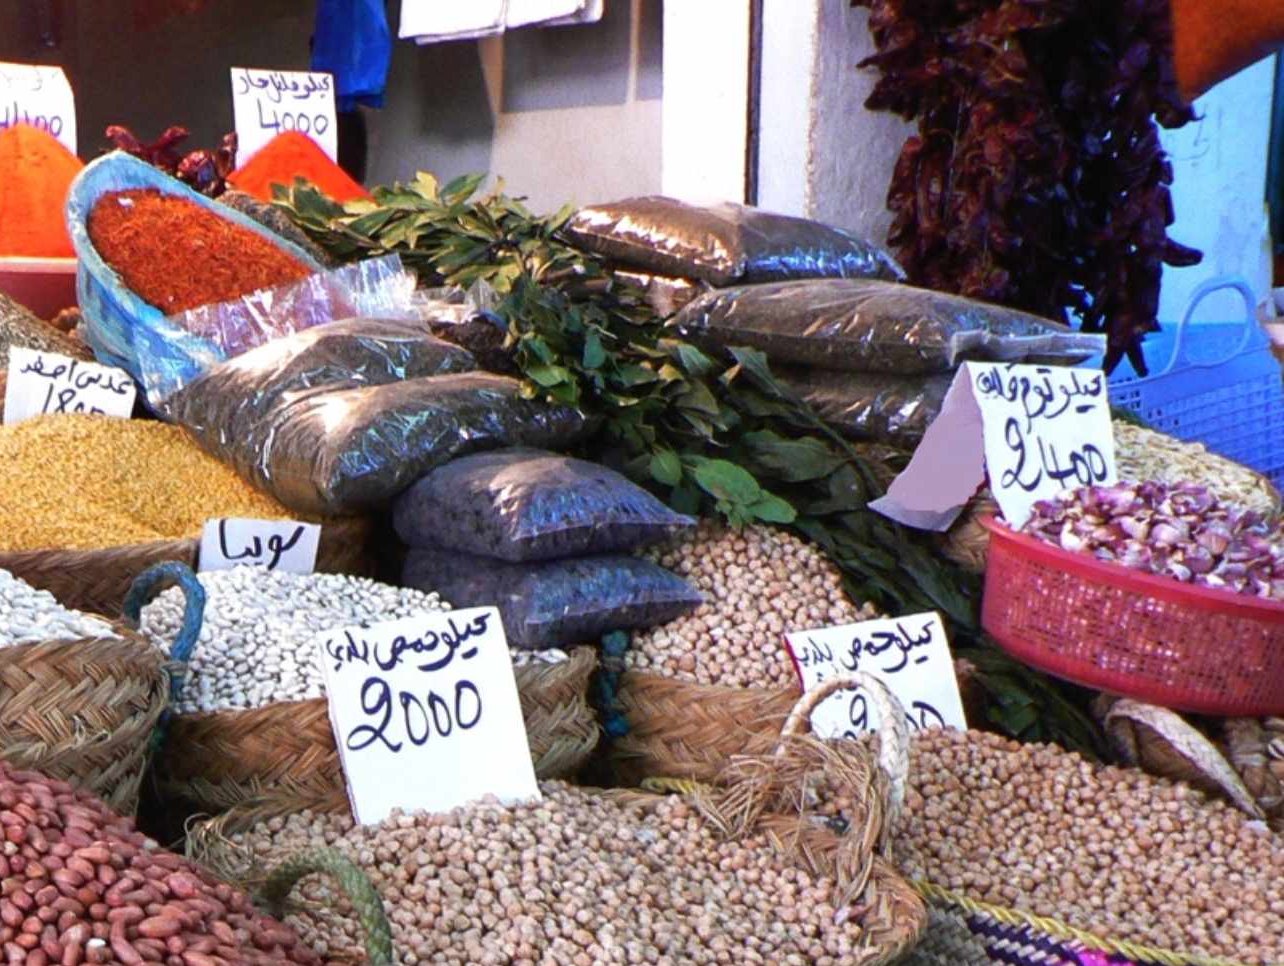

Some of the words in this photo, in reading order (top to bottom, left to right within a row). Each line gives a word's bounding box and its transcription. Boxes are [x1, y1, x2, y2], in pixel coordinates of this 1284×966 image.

[256, 97, 329, 136] 4000
[75, 369, 131, 395] عدس
[1000, 417, 1107, 492] 2400
[418, 611, 492, 671] كيلو
[880, 620, 935, 673] كيلو
[346, 674, 483, 753] 2000
